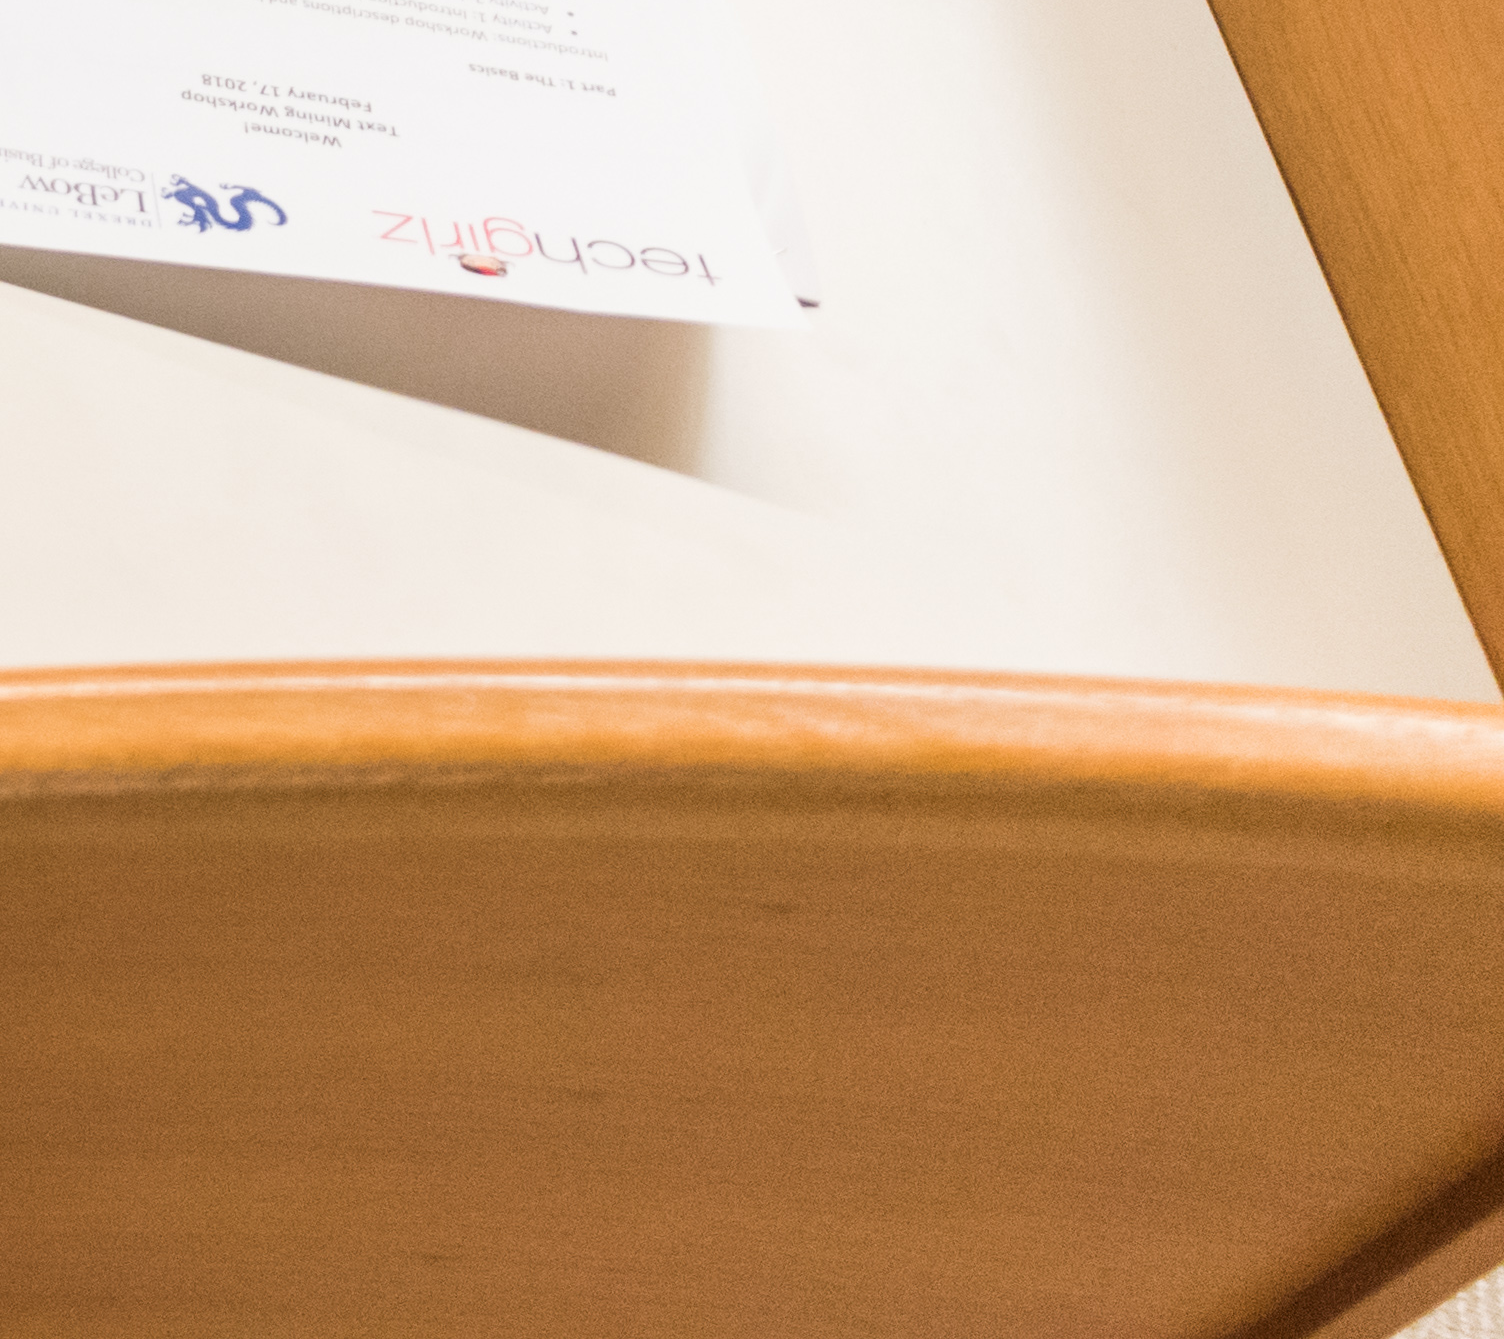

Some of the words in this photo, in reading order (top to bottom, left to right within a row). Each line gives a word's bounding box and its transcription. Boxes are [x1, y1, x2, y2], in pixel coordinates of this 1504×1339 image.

[201, 73, 246, 92] 2018
[468, 63, 519, 81] Basics
[524, 72, 555, 87] The
[252, 80, 279, 97] 17,
[287, 86, 372, 113] February
[581, 82, 616, 97] Part
[180, 89, 279, 118] Workshop
[283, 105, 351, 130] Mining
[357, 120, 397, 137] Text
[243, 122, 342, 147] Welcome!
[46, 155, 70, 170] of
[71, 156, 146, 183] College
[18, 173, 147, 214] LeBow
[370, 208, 722, 288] techgirlz
